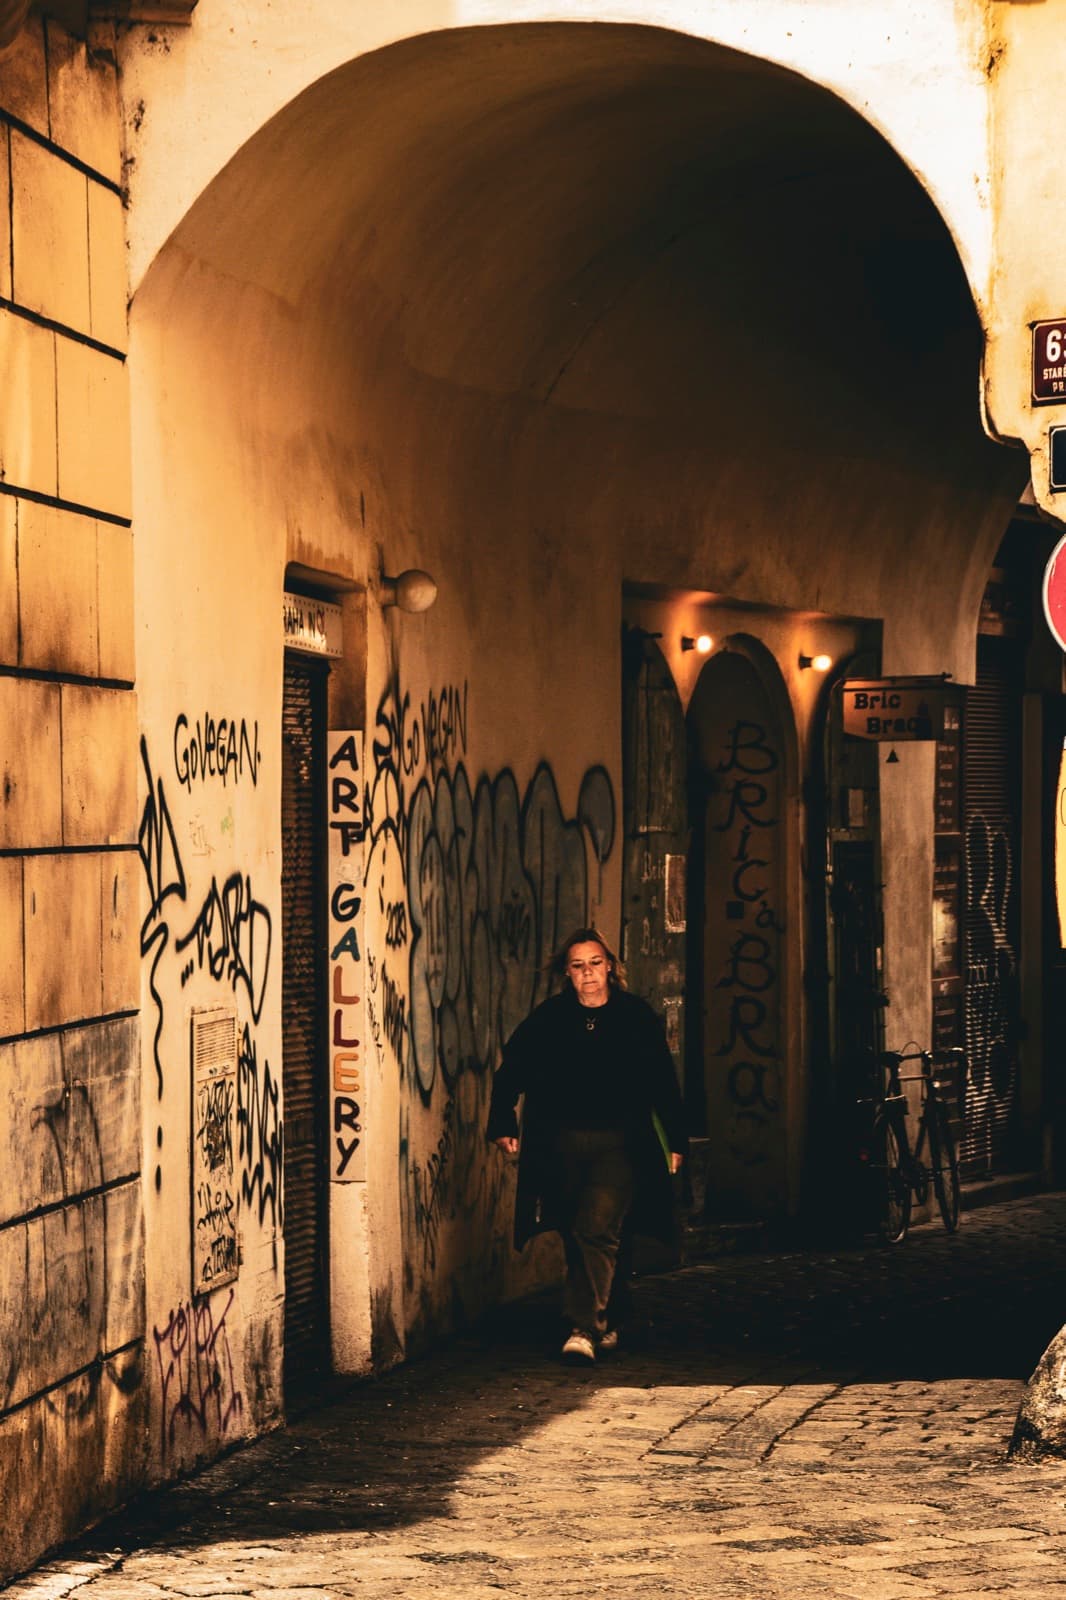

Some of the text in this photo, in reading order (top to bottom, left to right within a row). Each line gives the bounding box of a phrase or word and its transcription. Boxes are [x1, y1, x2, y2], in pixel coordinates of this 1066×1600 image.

[1046, 329, 1066, 362] 6
[1052, 381, 1066, 392] PR
[854, 692, 901, 709] Bric
[329, 735, 363, 1177] ART GALLERY
